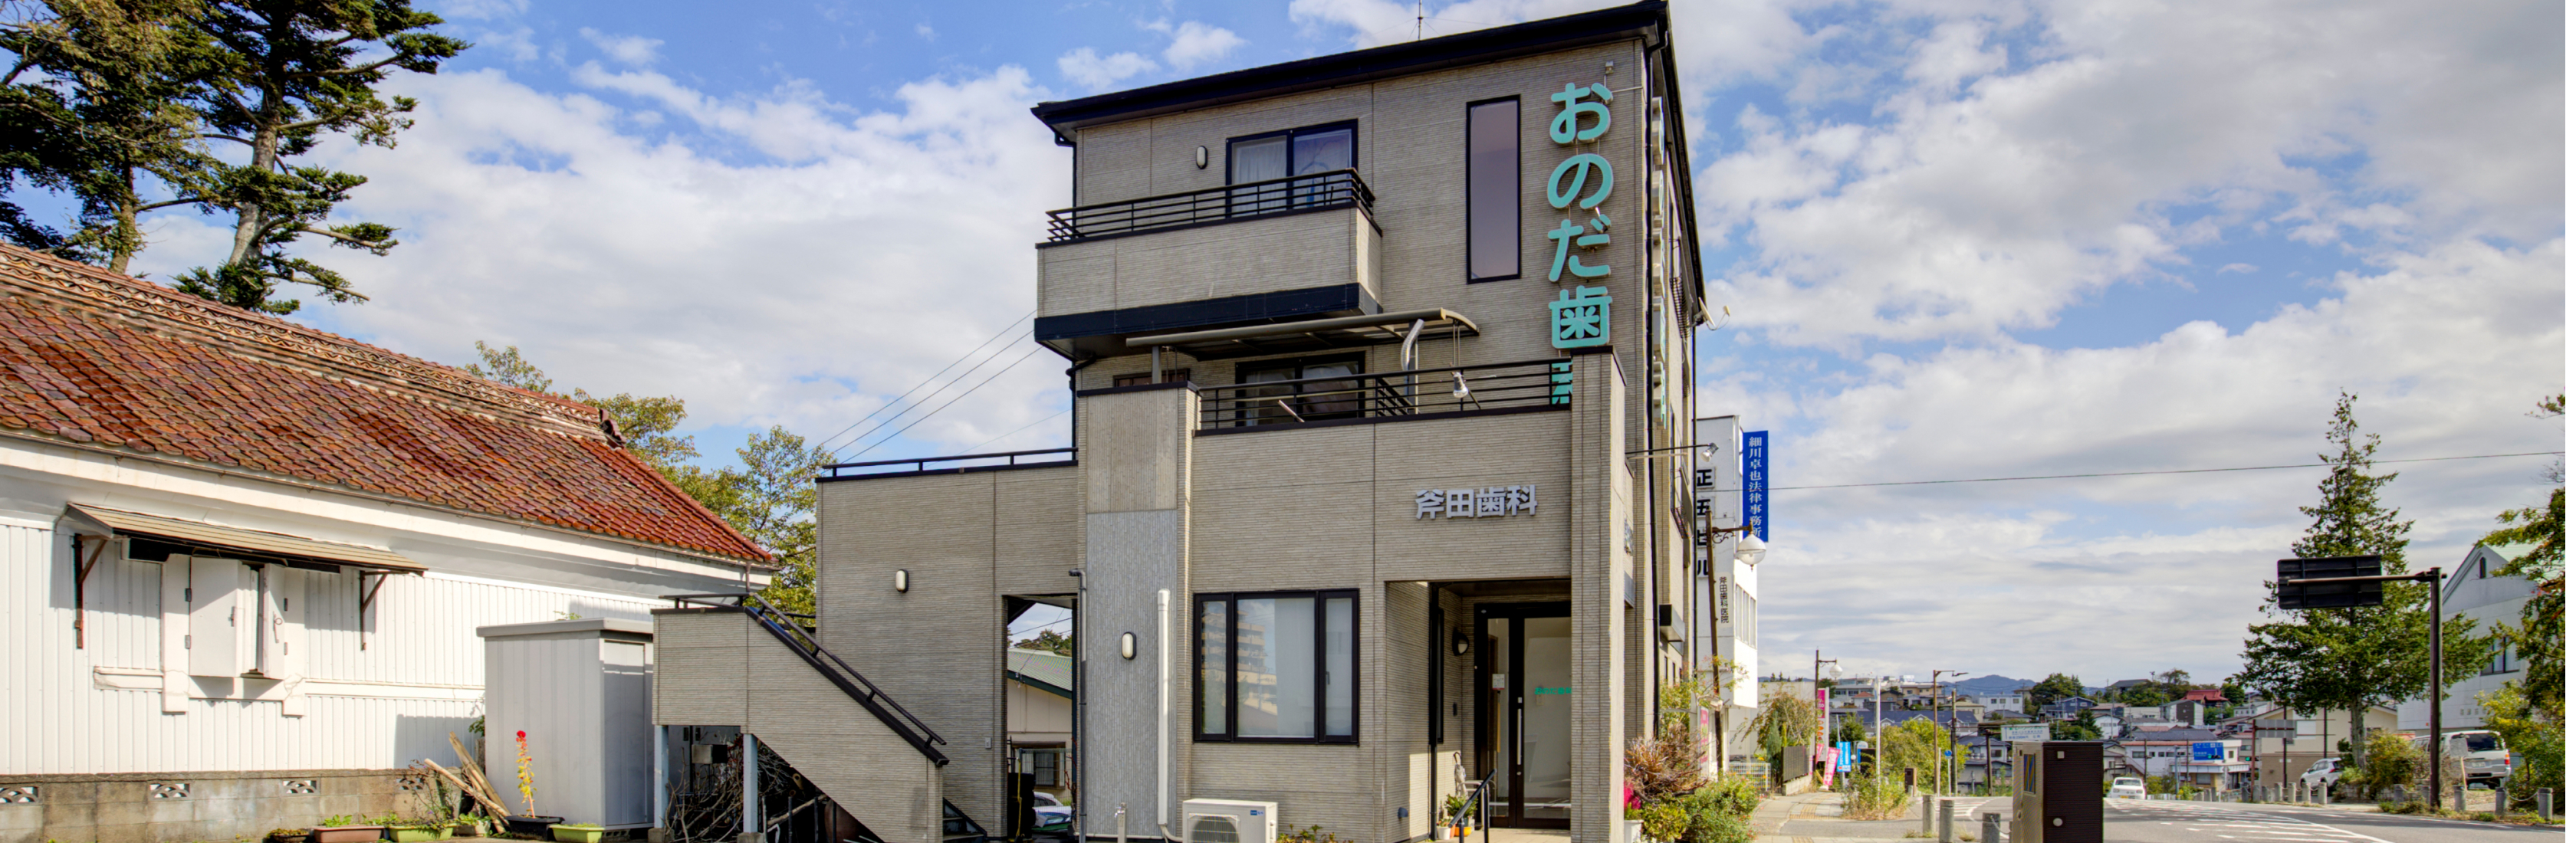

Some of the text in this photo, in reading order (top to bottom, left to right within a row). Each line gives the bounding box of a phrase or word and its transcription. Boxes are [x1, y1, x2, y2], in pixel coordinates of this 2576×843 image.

[1415, 484, 1538, 520] 斧田歯科
[1748, 436, 1763, 537] 細川卓也法律事務所
